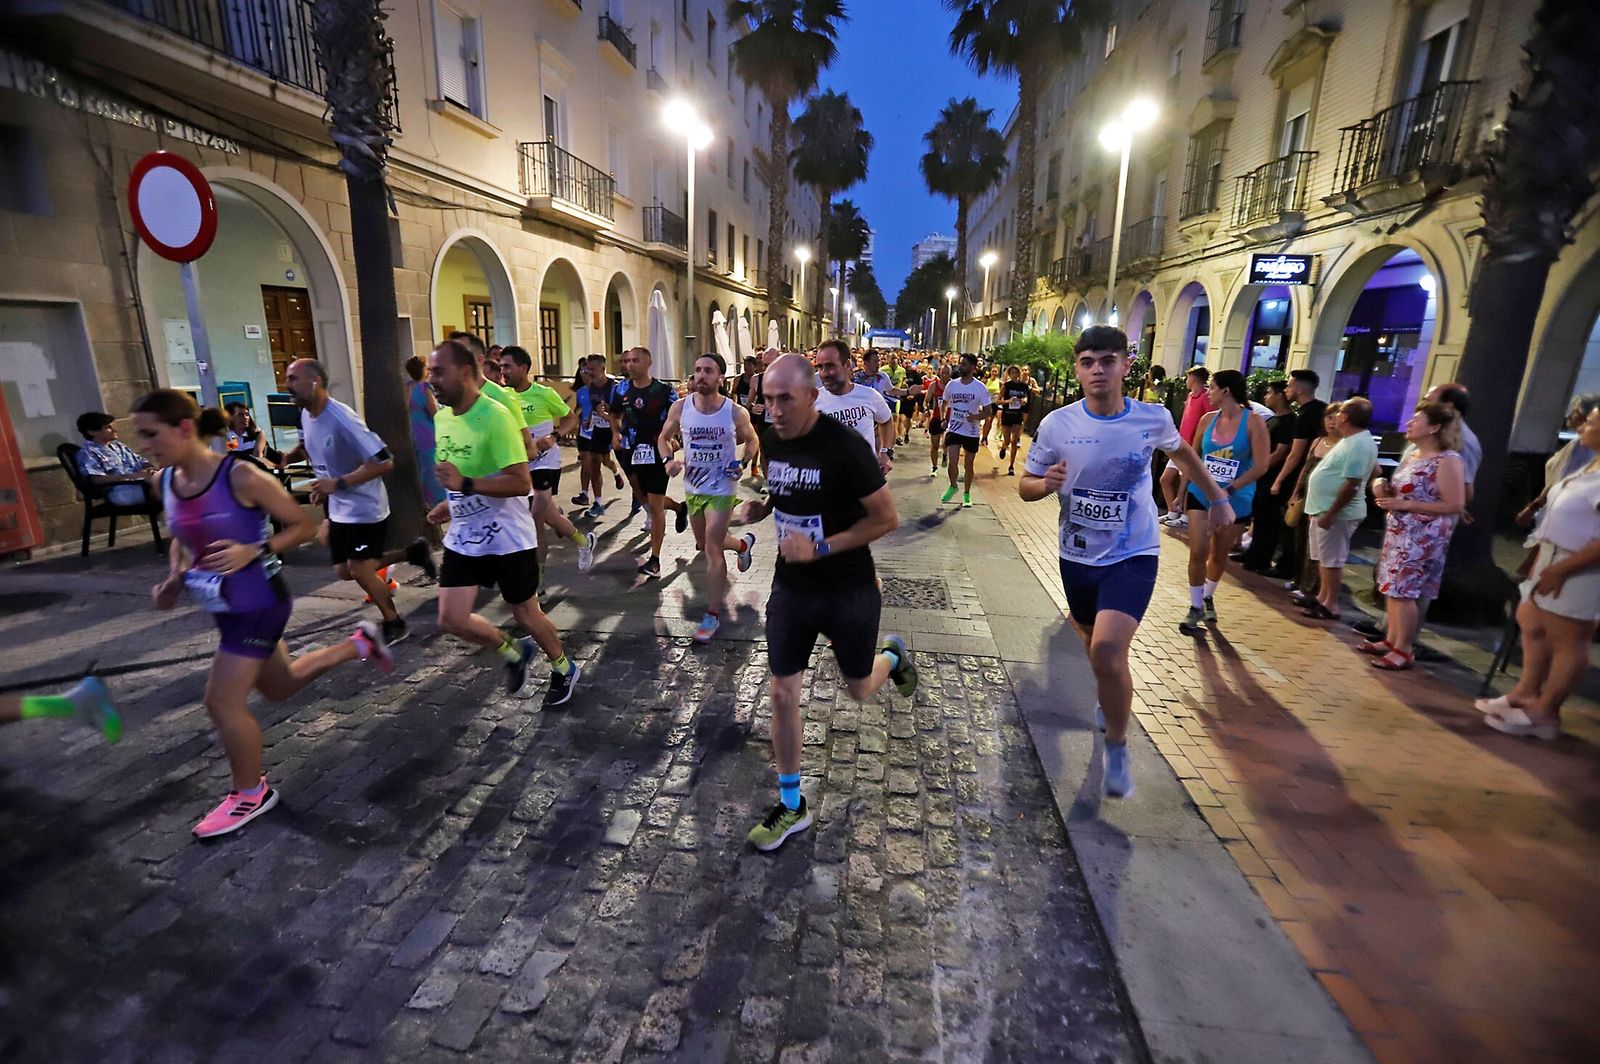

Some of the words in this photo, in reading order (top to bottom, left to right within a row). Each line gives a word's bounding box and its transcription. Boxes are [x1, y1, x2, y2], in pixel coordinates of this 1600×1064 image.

[698, 451, 715, 462] 379
[800, 468, 821, 485] FUN
[1210, 464, 1227, 476] 549
[1084, 503, 1111, 520] 696
